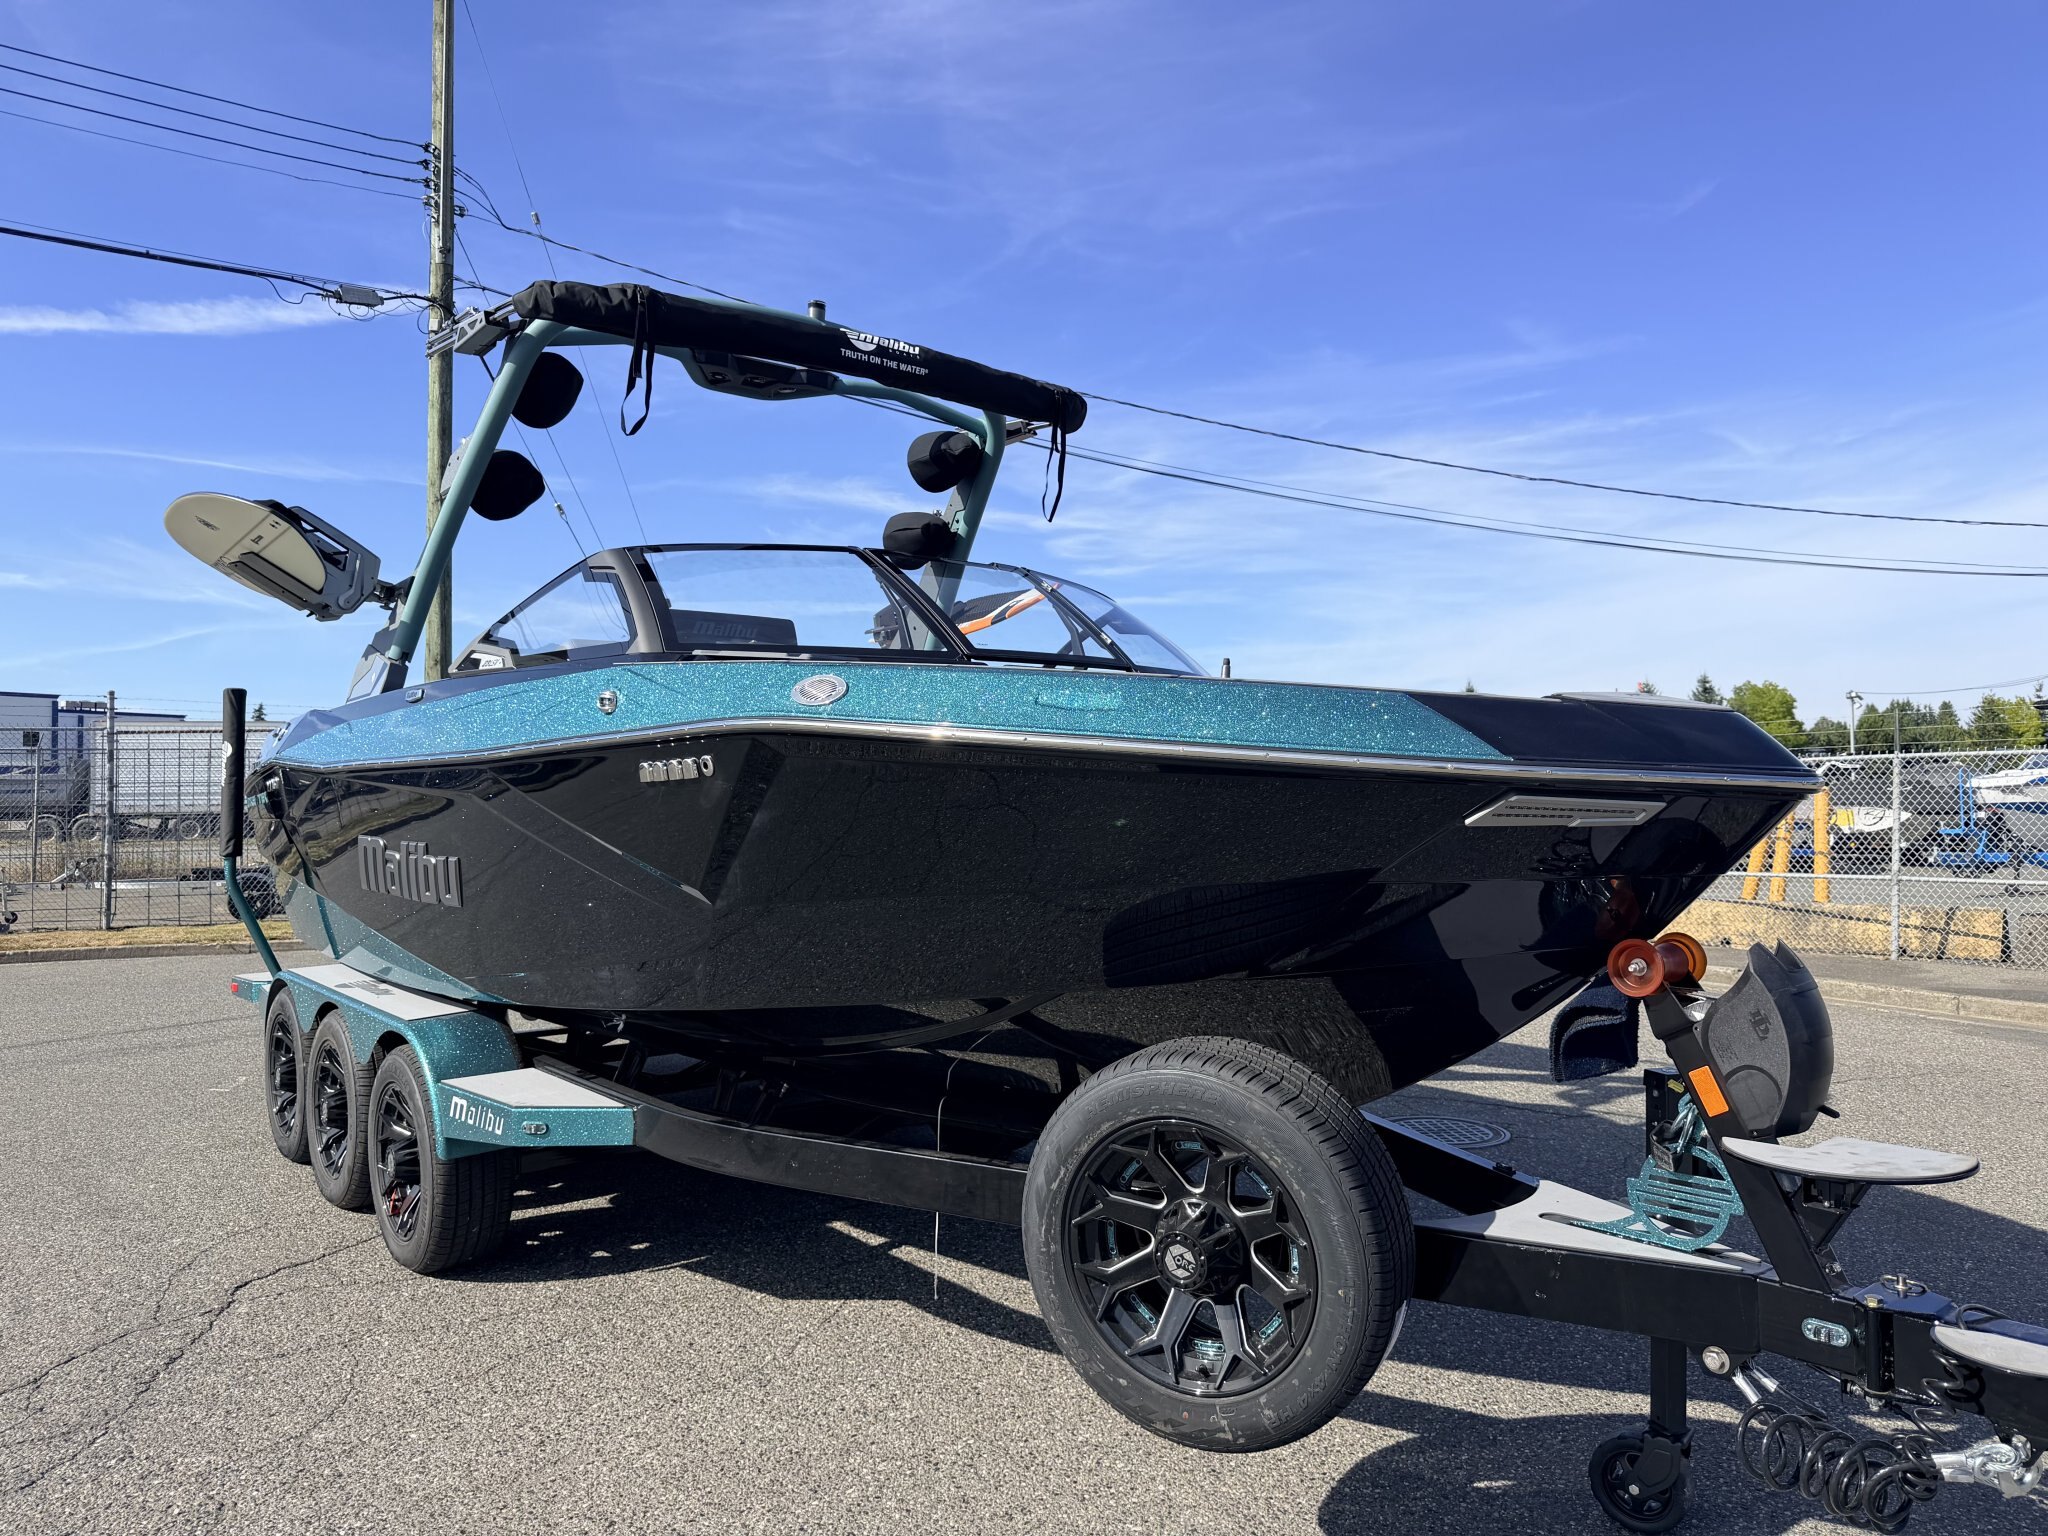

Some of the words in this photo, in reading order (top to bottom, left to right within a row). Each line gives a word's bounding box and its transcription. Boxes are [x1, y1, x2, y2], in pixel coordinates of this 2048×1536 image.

[840, 348, 868, 362] TRUTH
[869, 355, 881, 365] ON
[883, 358, 898, 369] THE
[1086, 1081, 1222, 1120] HEMISPHERE
